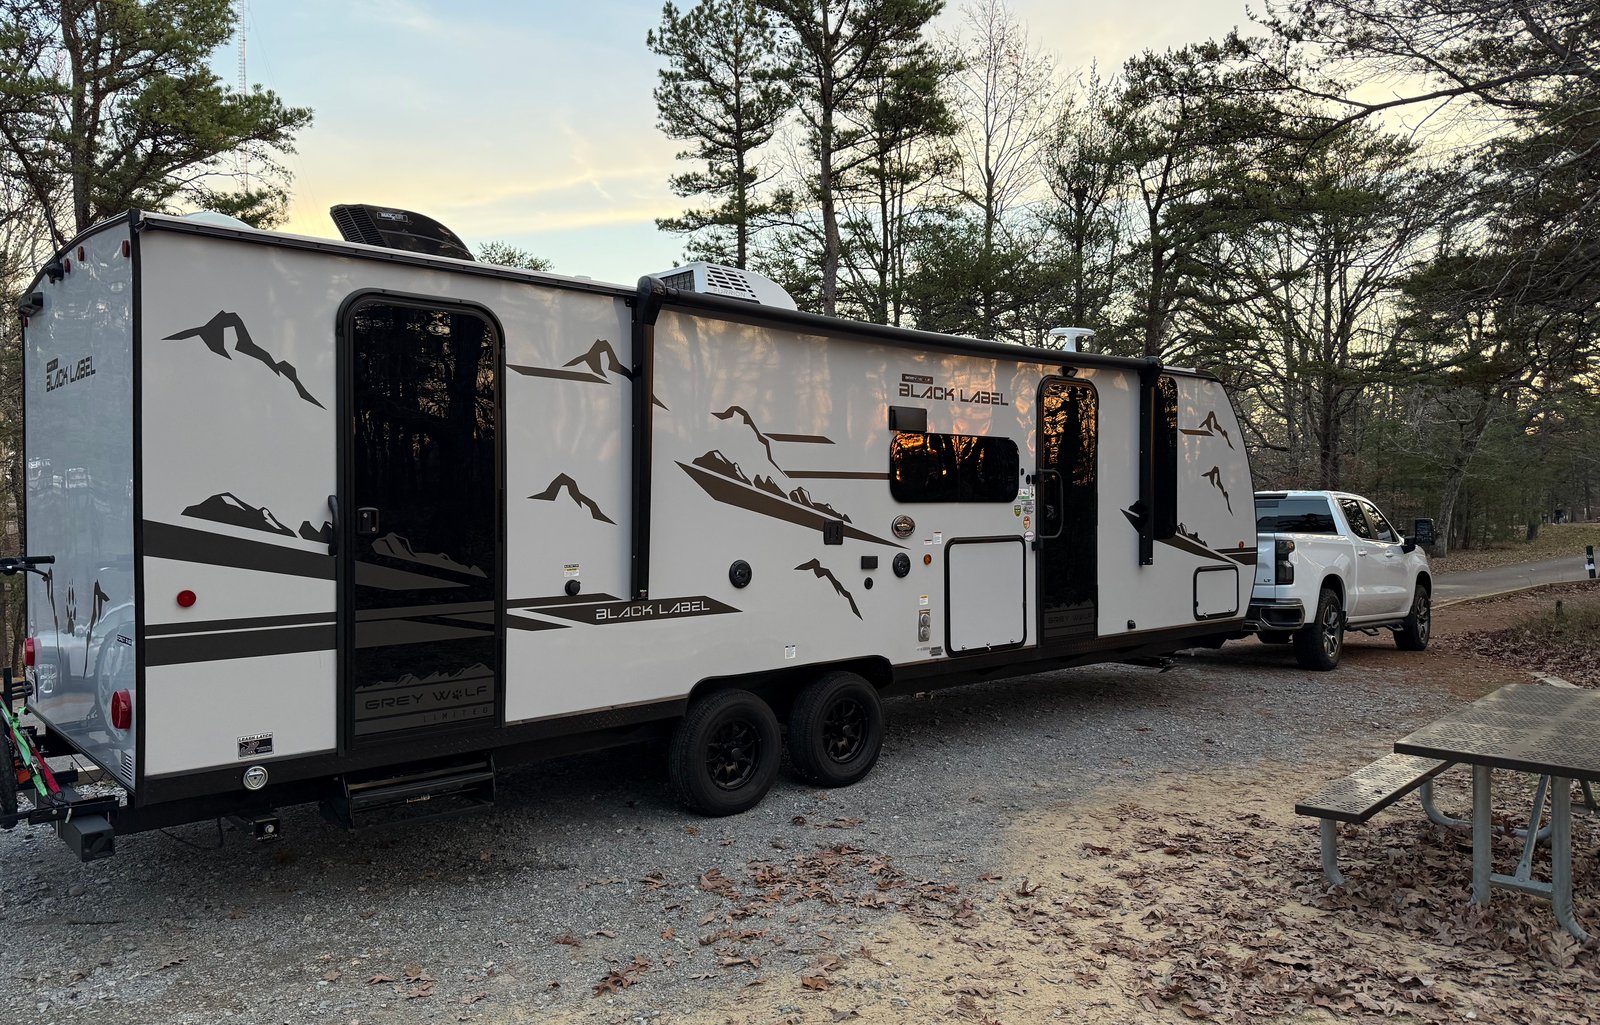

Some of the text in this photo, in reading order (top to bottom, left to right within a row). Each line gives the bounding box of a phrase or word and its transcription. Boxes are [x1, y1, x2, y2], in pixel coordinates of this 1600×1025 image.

[46, 365, 69, 393] BLACK
[70, 355, 96, 383] LABEL
[898, 382, 1009, 406] BLACK LABEL
[595, 600, 711, 620] BLACK LABEL
[364, 693, 424, 710] GREY
[423, 706, 489, 723] LIMITED
